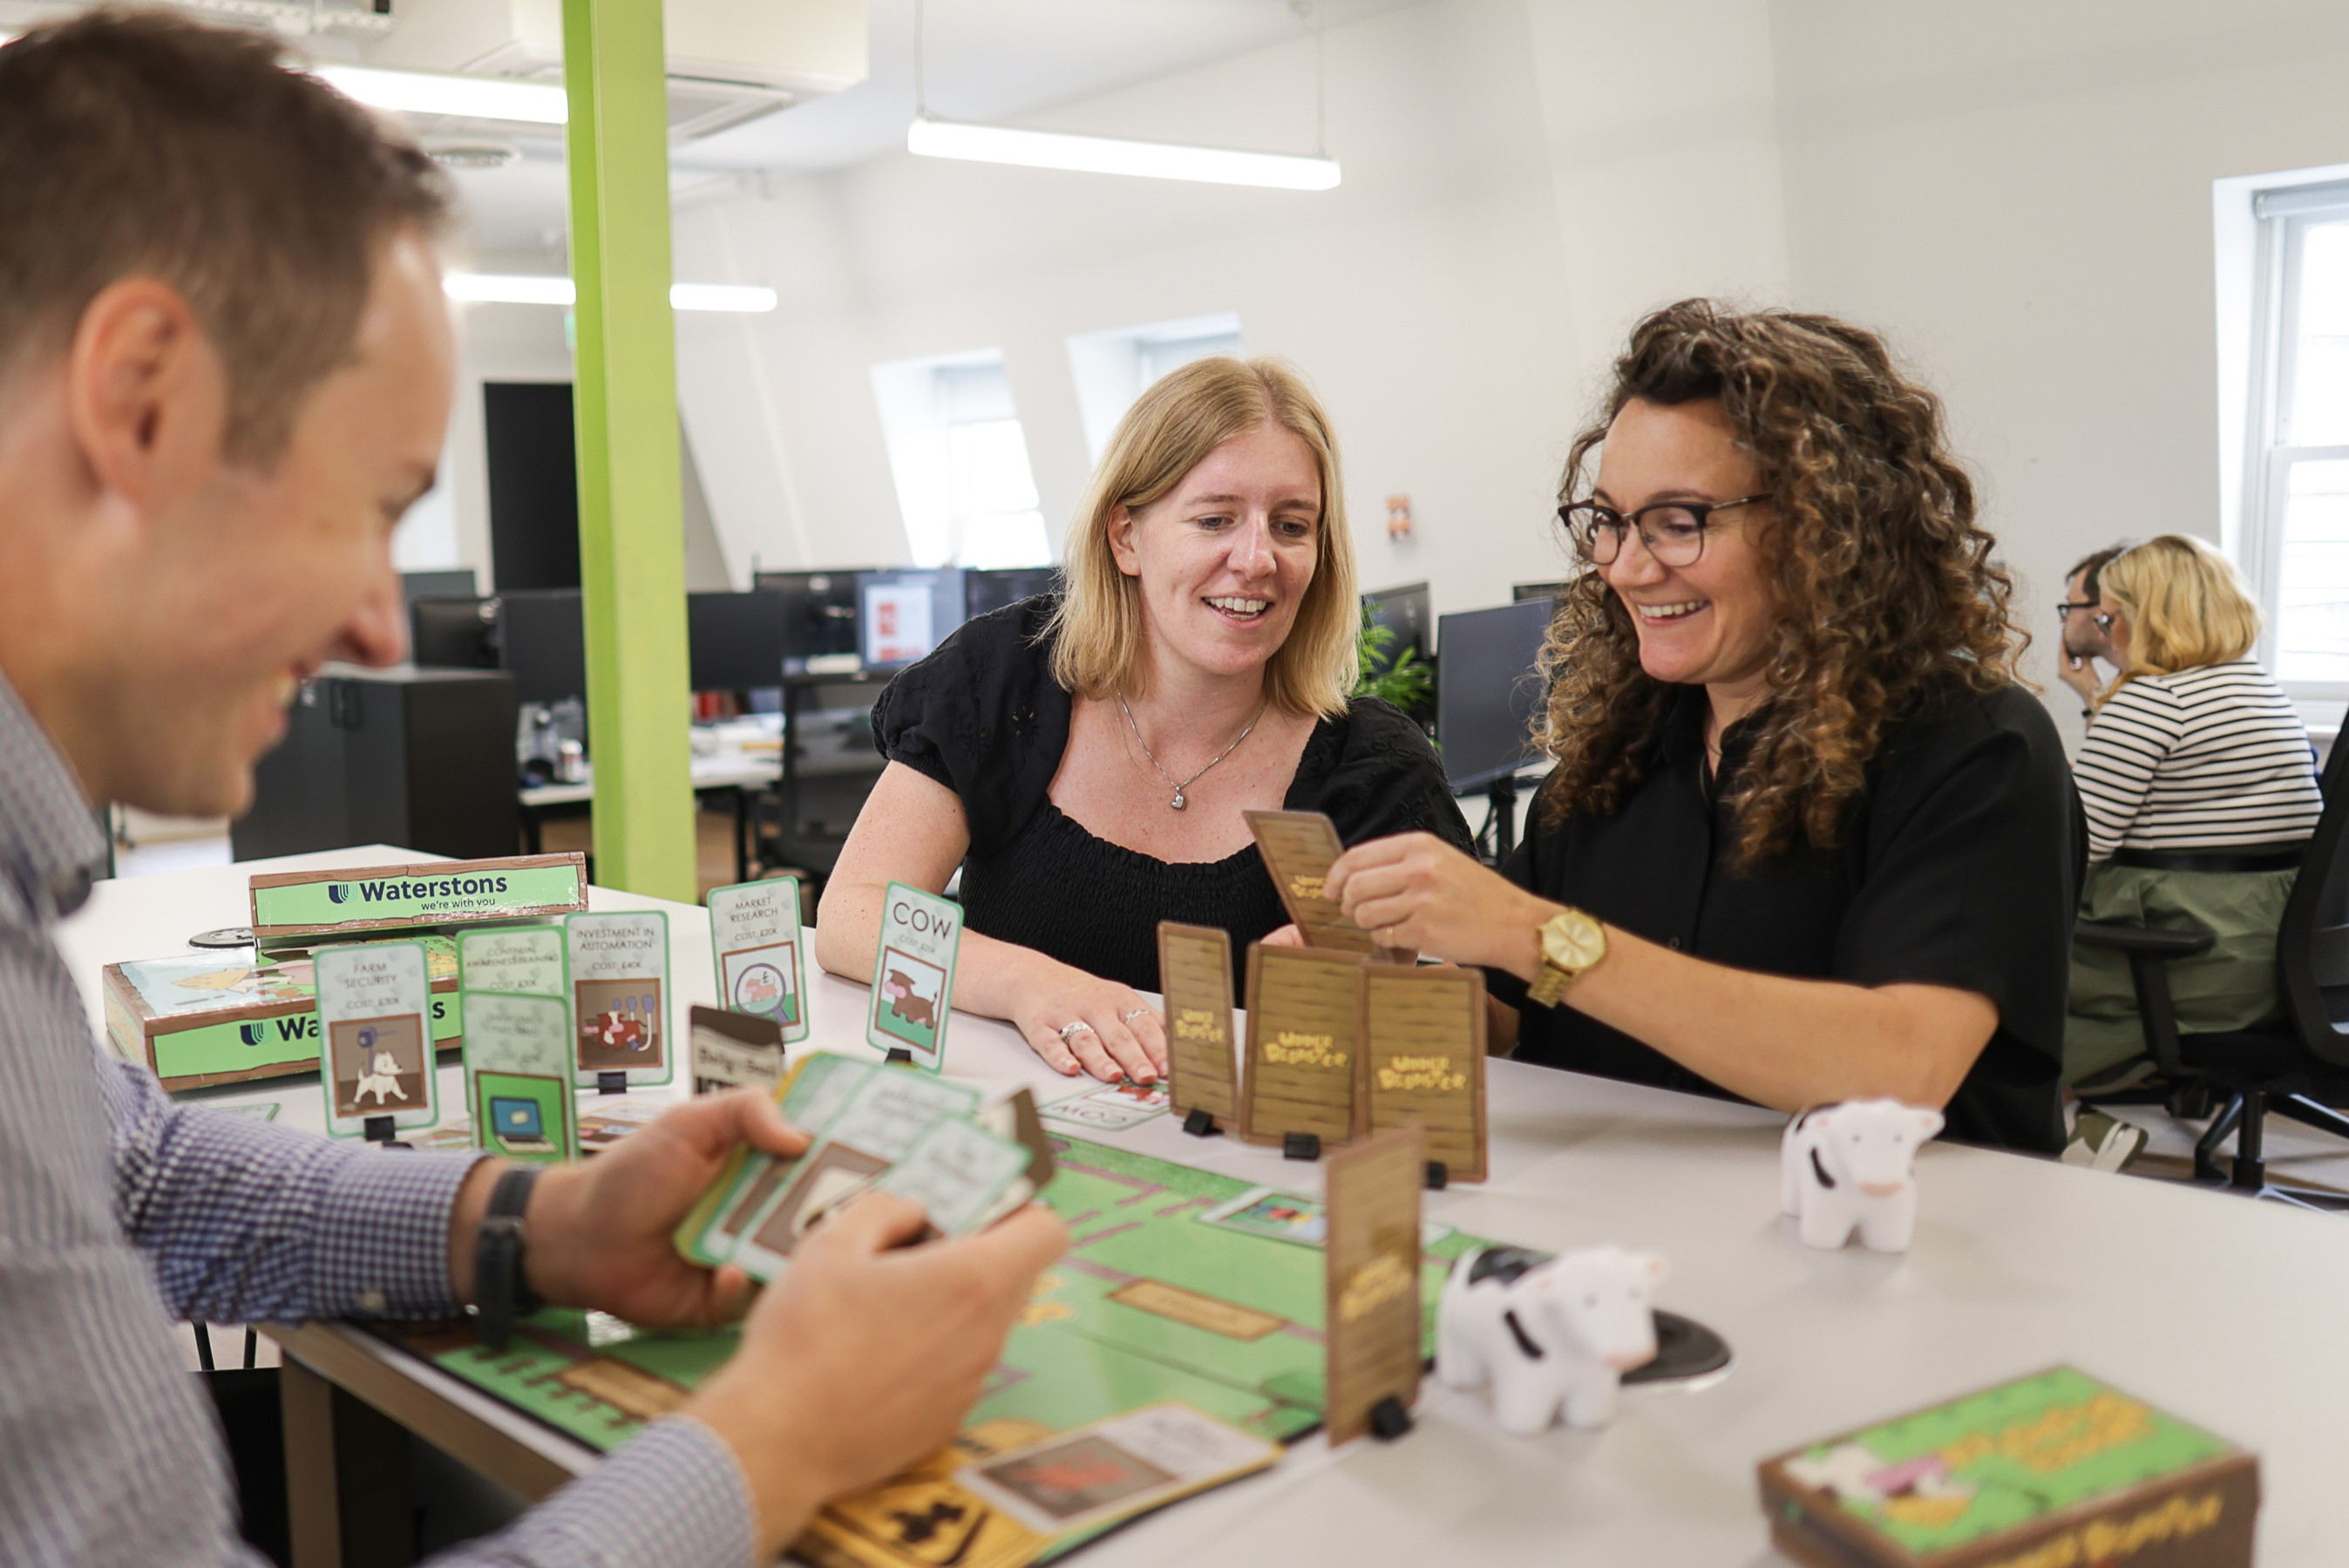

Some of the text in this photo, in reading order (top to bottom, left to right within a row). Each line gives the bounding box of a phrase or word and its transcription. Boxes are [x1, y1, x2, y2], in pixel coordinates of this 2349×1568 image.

[359, 876, 507, 902] Waterstons
[421, 897, 496, 910] we're with you
[735, 896, 771, 910] MARKET
[730, 907, 778, 923] RESEARCH
[893, 901, 952, 940] COW
[576, 927, 654, 939] INVESTMENT IN
[579, 940, 652, 951] AUTOMATION
[353, 963, 387, 974] FARM
[344, 975, 397, 988] SECURITY
[1051, 1105, 1128, 1124] COW
